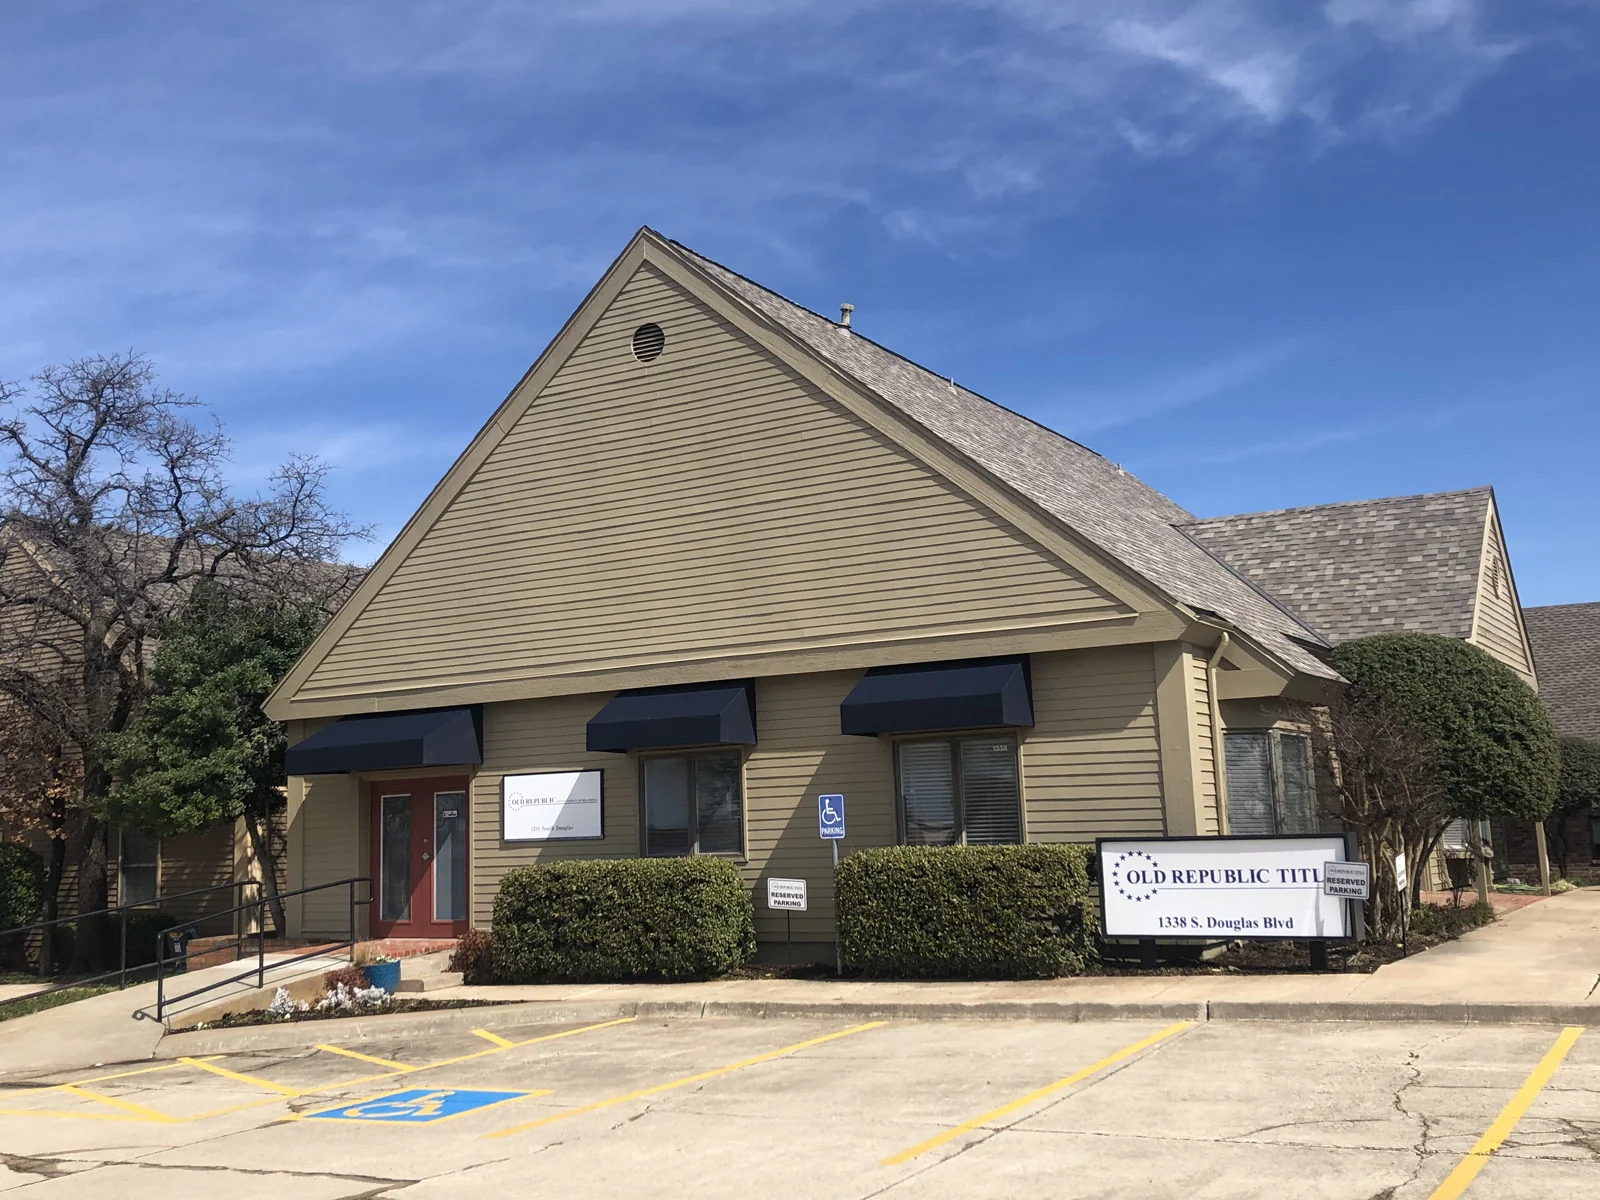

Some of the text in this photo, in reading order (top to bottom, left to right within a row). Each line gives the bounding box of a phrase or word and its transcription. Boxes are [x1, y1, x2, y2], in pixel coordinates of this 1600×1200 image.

[822, 827, 843, 835] PARKING
[1126, 869, 1167, 885] OLD
[1171, 868, 1270, 884] REPUBLIC
[1276, 868, 1324, 883] TITL
[1326, 877, 1366, 886] RESERVED
[1329, 886, 1362, 895] PARKING
[1157, 916, 1294, 932] 1338 S. Douglas Blvd
